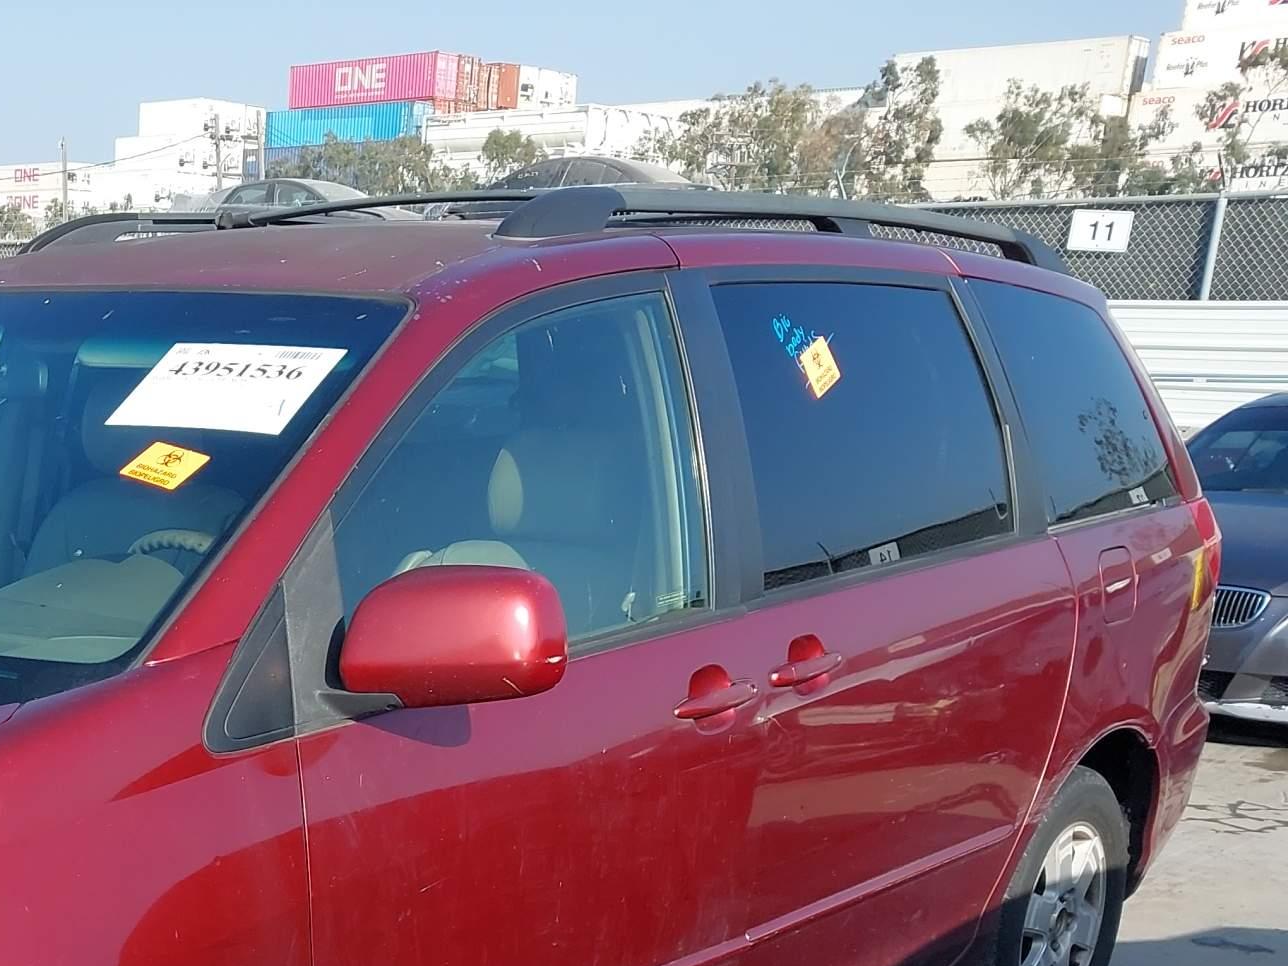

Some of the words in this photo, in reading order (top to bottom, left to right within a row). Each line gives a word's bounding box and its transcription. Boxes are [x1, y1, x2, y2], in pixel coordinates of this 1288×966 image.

[1171, 34, 1206, 46] seaco
[335, 63, 386, 92] ONE
[1142, 95, 1176, 106] seaco
[14, 168, 40, 183] ONE
[1090, 221, 1114, 241] 11
[169, 360, 307, 381] 43951536
[136, 463, 177, 479] BIOHAZARD
